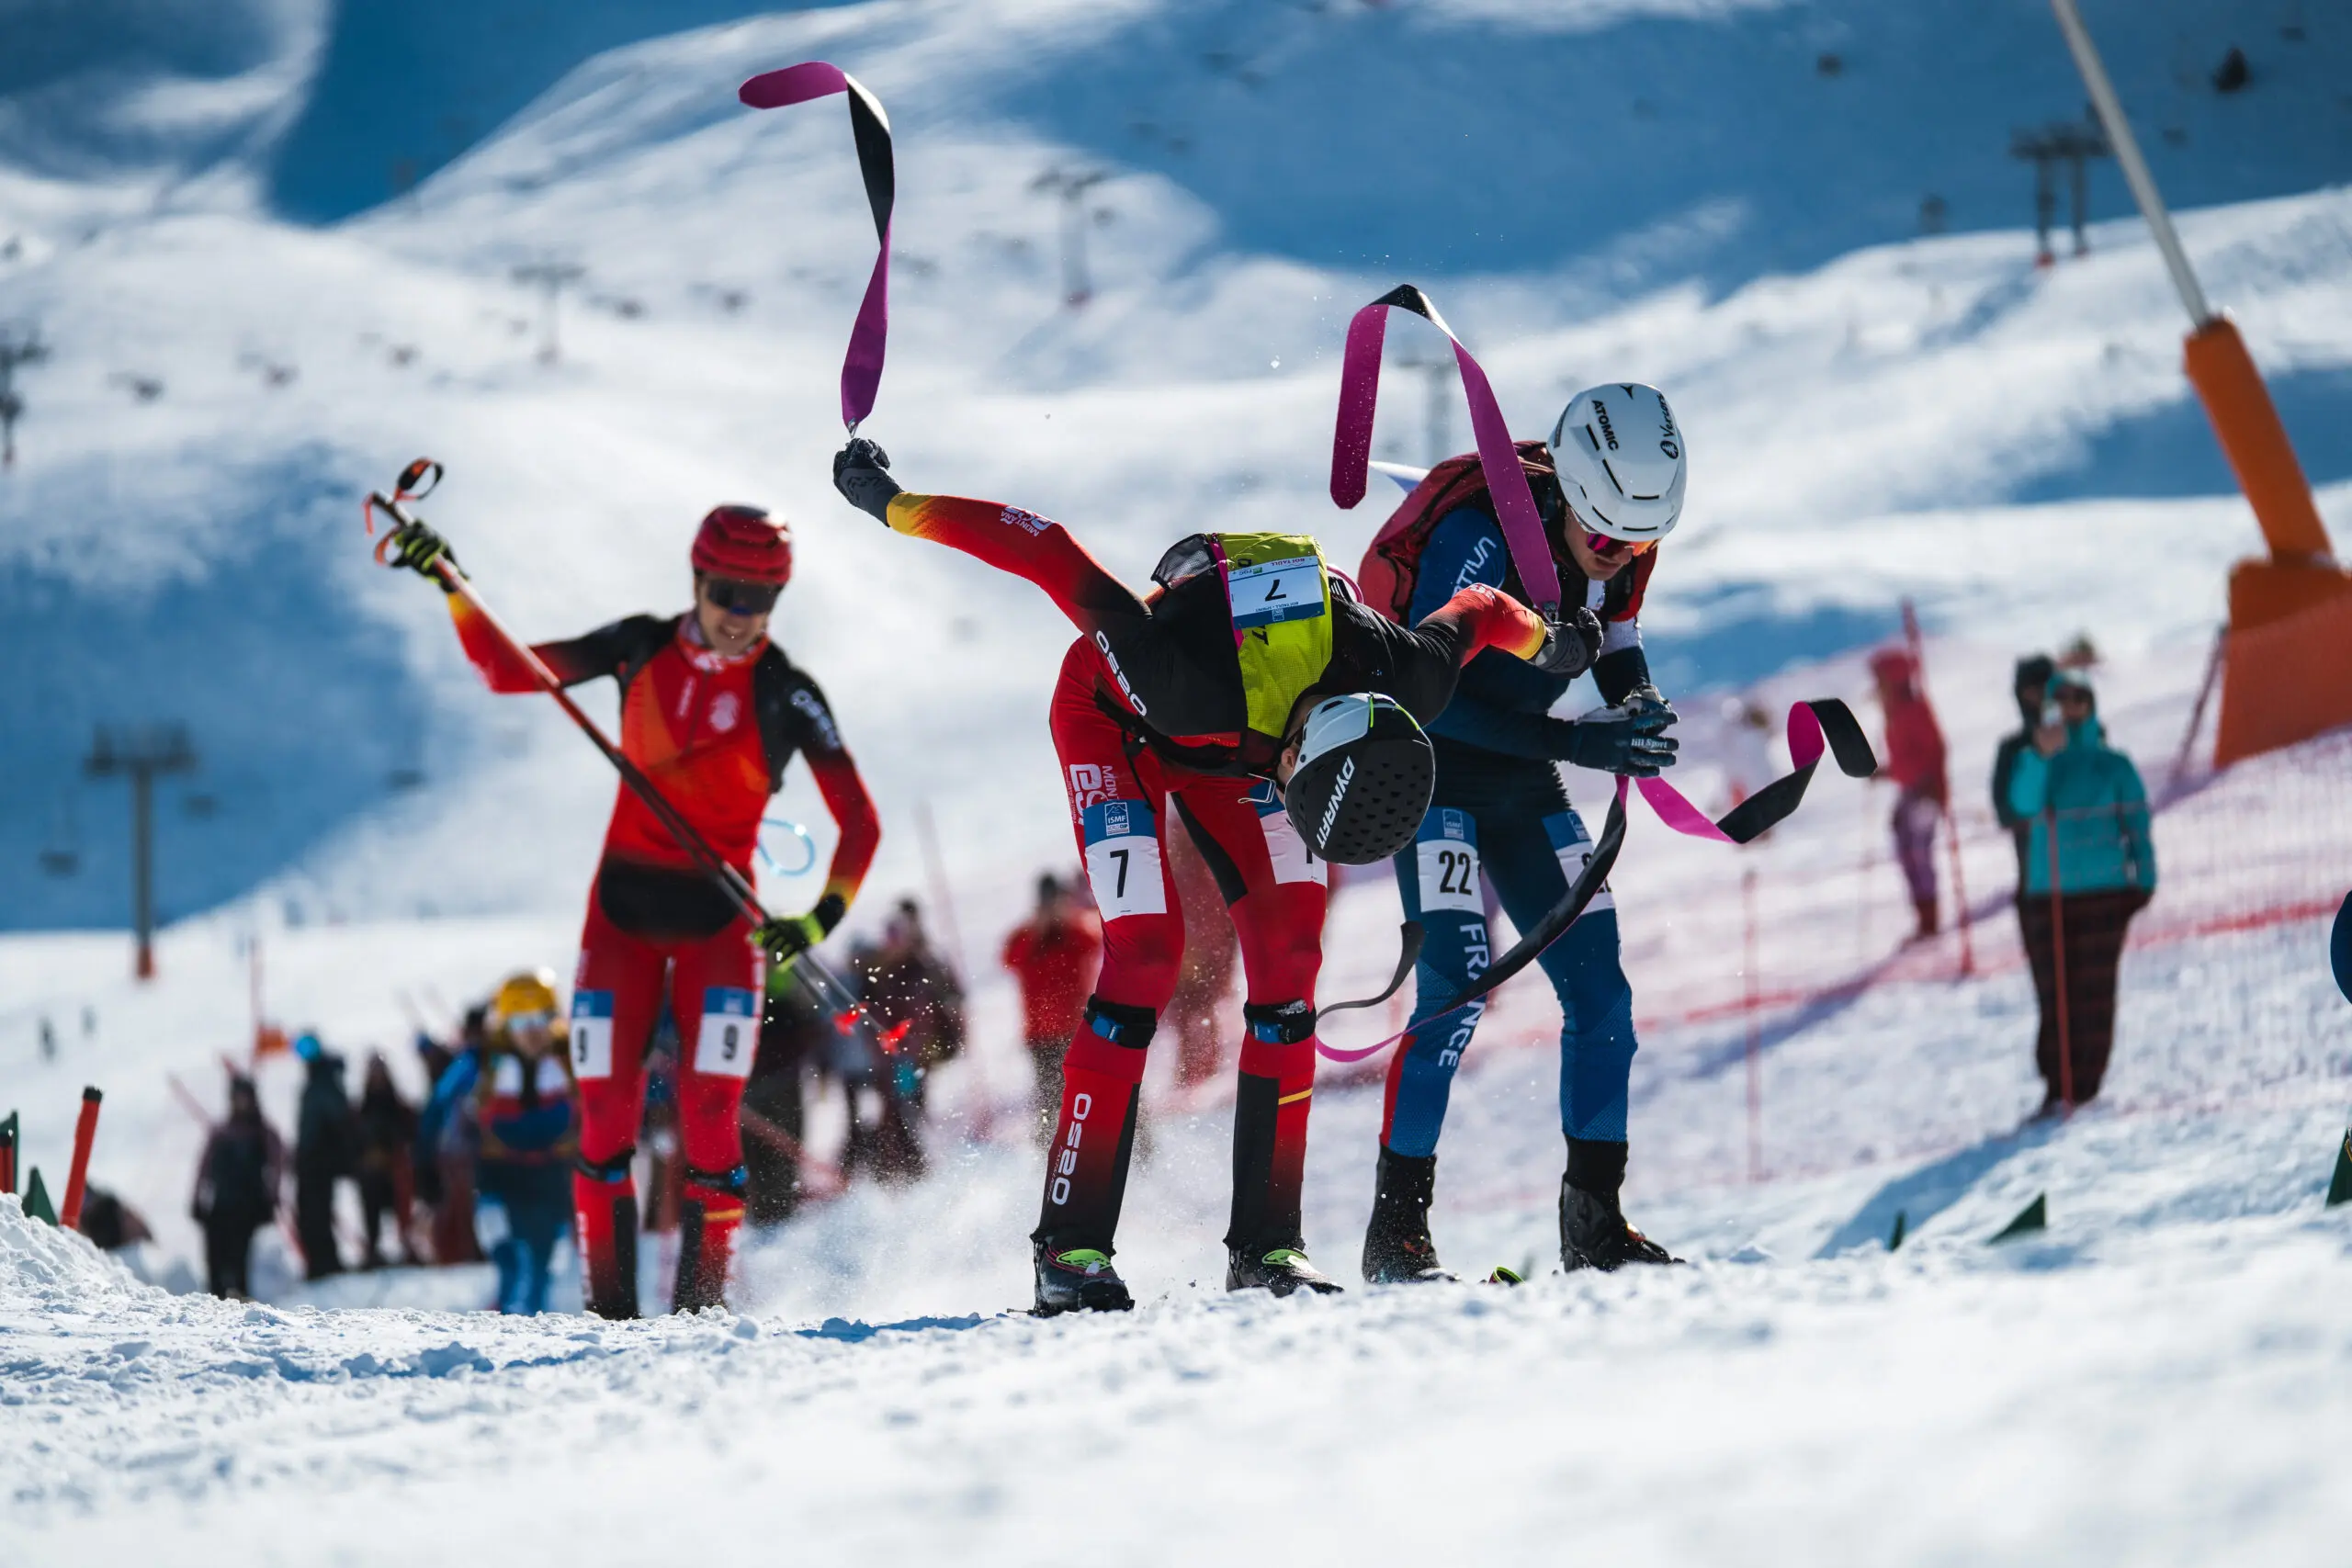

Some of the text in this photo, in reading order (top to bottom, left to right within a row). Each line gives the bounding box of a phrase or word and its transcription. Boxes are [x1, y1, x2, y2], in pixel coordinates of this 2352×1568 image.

[1591, 400, 1619, 451] ATOMIC
[1000, 510, 1040, 537] MONTAÑA
[1265, 579, 1286, 602] 7
[1107, 815, 1126, 824] ISMF
[1317, 755, 1355, 850] DYNAFIT
[1110, 849, 1129, 898] 7
[1438, 850, 1473, 896] 22
[1438, 923, 1490, 1068] FRNCE
[722, 1023, 738, 1061] 9
